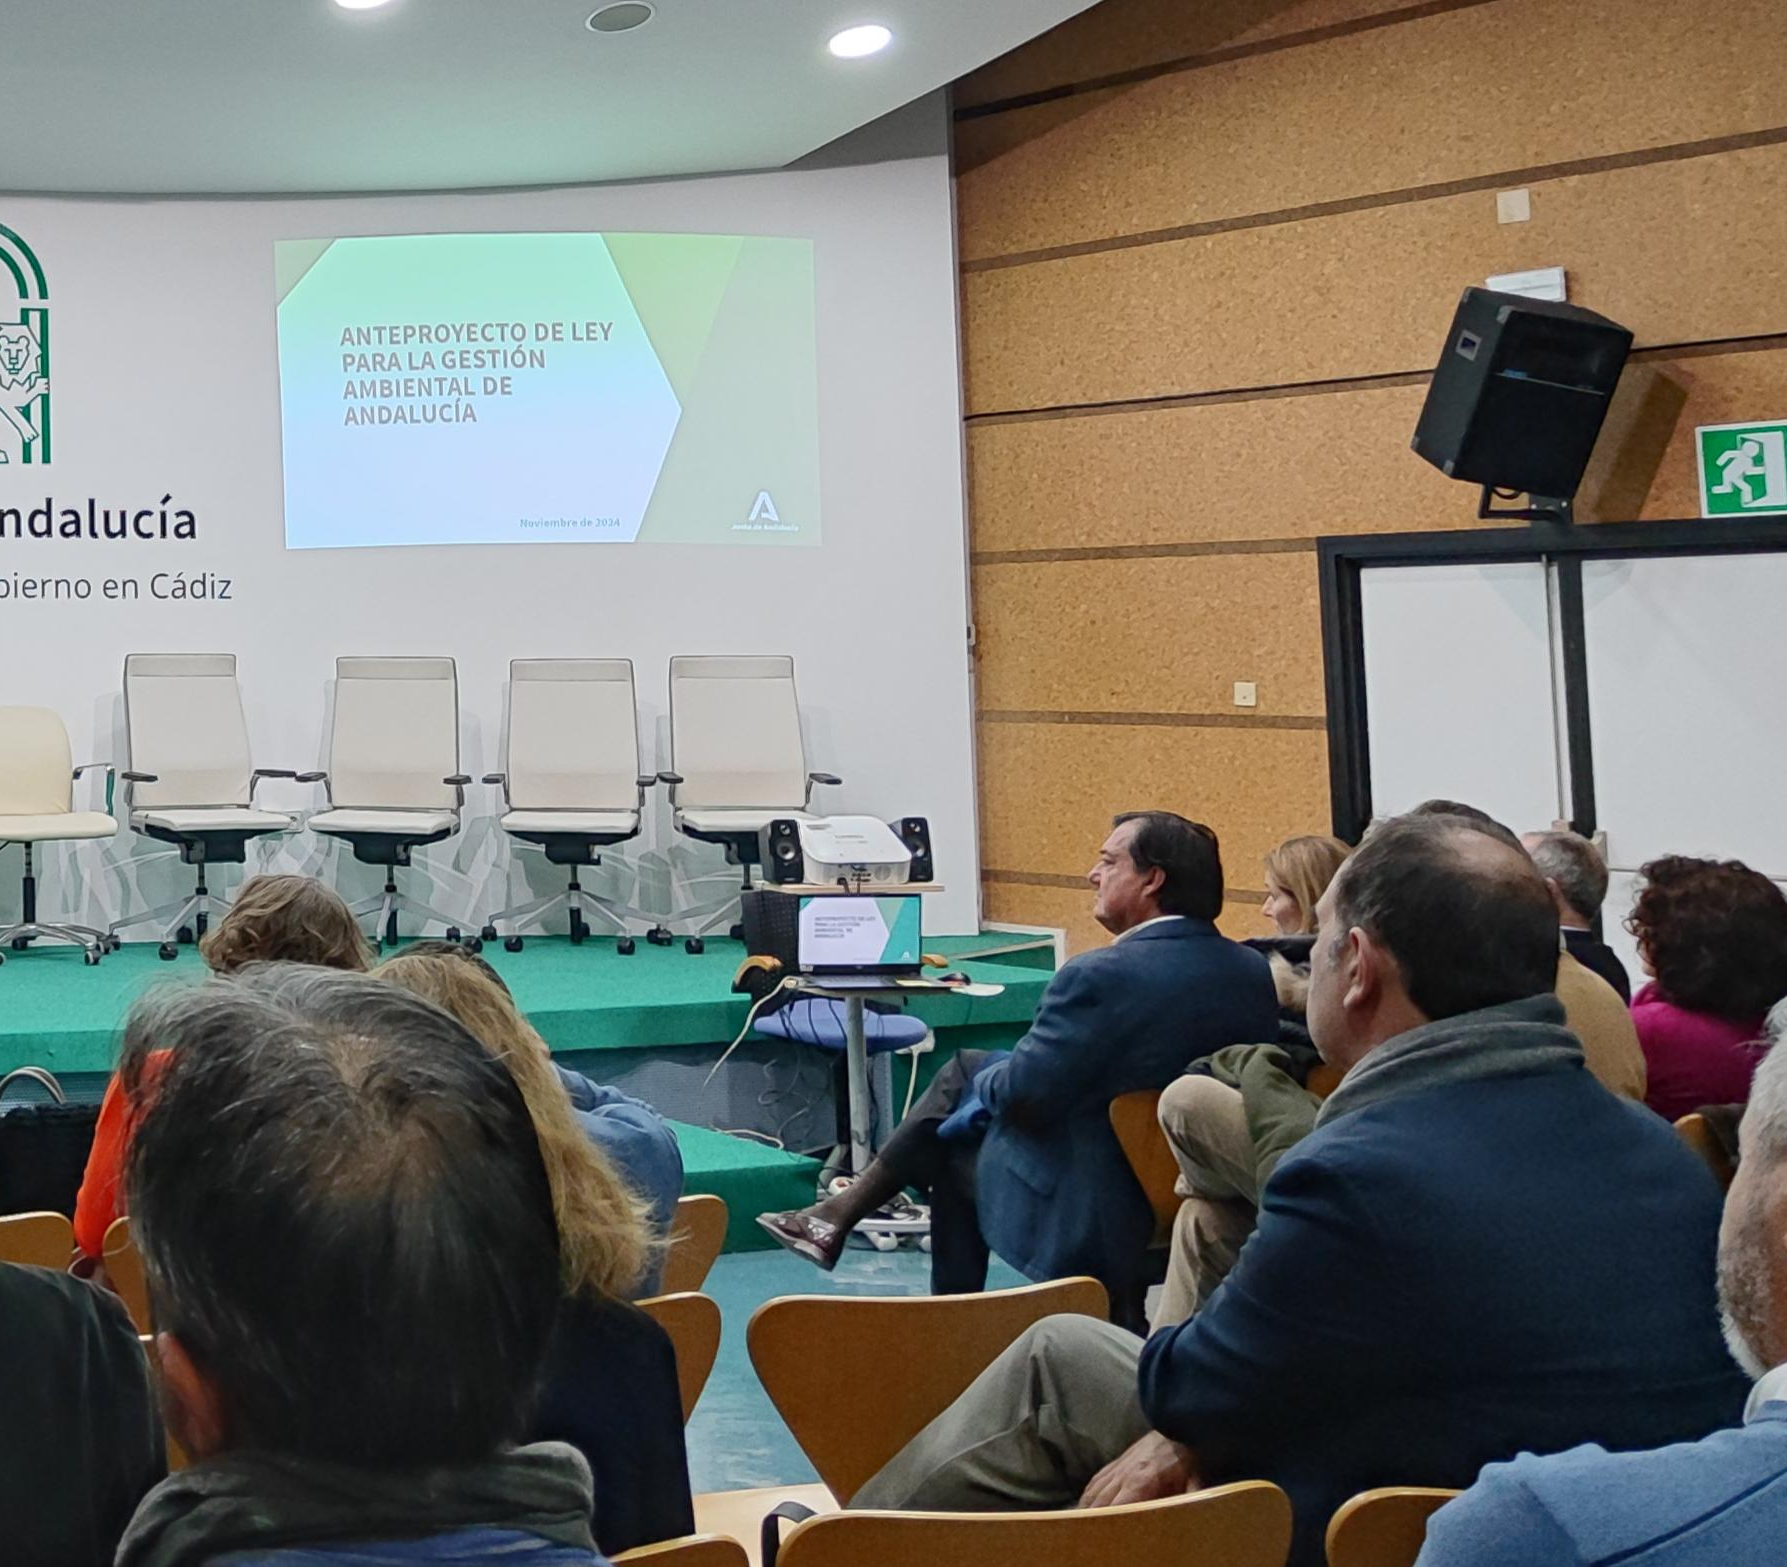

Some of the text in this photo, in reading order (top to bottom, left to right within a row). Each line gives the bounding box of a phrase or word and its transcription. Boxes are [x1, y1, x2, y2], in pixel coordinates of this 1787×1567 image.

[340, 322, 613, 347] ANTEPROYECTO DE LEY
[343, 344, 545, 373] PARA LA GESTIÓN
[343, 376, 512, 400] AMBIENTAL DE
[343, 397, 477, 426] ANDALUCÍA
[520, 517, 621, 528] Noviembre de 2024
[103, 579, 138, 599] en
[151, 572, 232, 599] Cádiz
